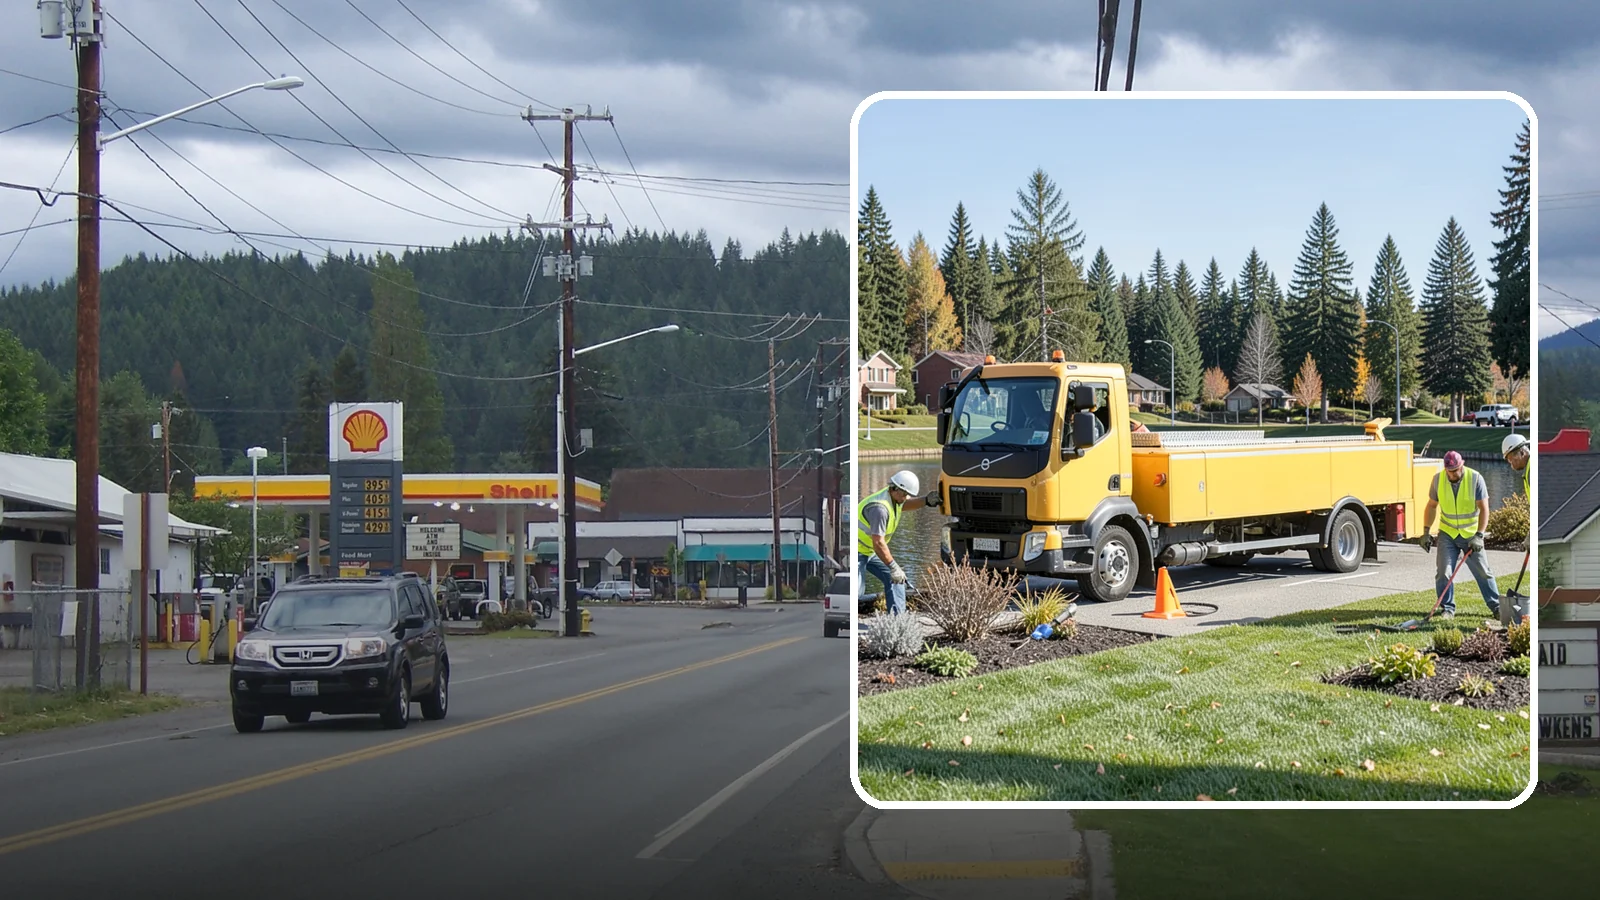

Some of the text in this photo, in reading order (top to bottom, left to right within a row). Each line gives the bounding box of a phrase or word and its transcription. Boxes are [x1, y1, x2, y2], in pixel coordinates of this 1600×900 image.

[366, 480, 384, 490] 395
[490, 484, 547, 499] Shell
[366, 494, 384, 504] 405
[366, 508, 384, 518] 415
[366, 522, 384, 532] 429
